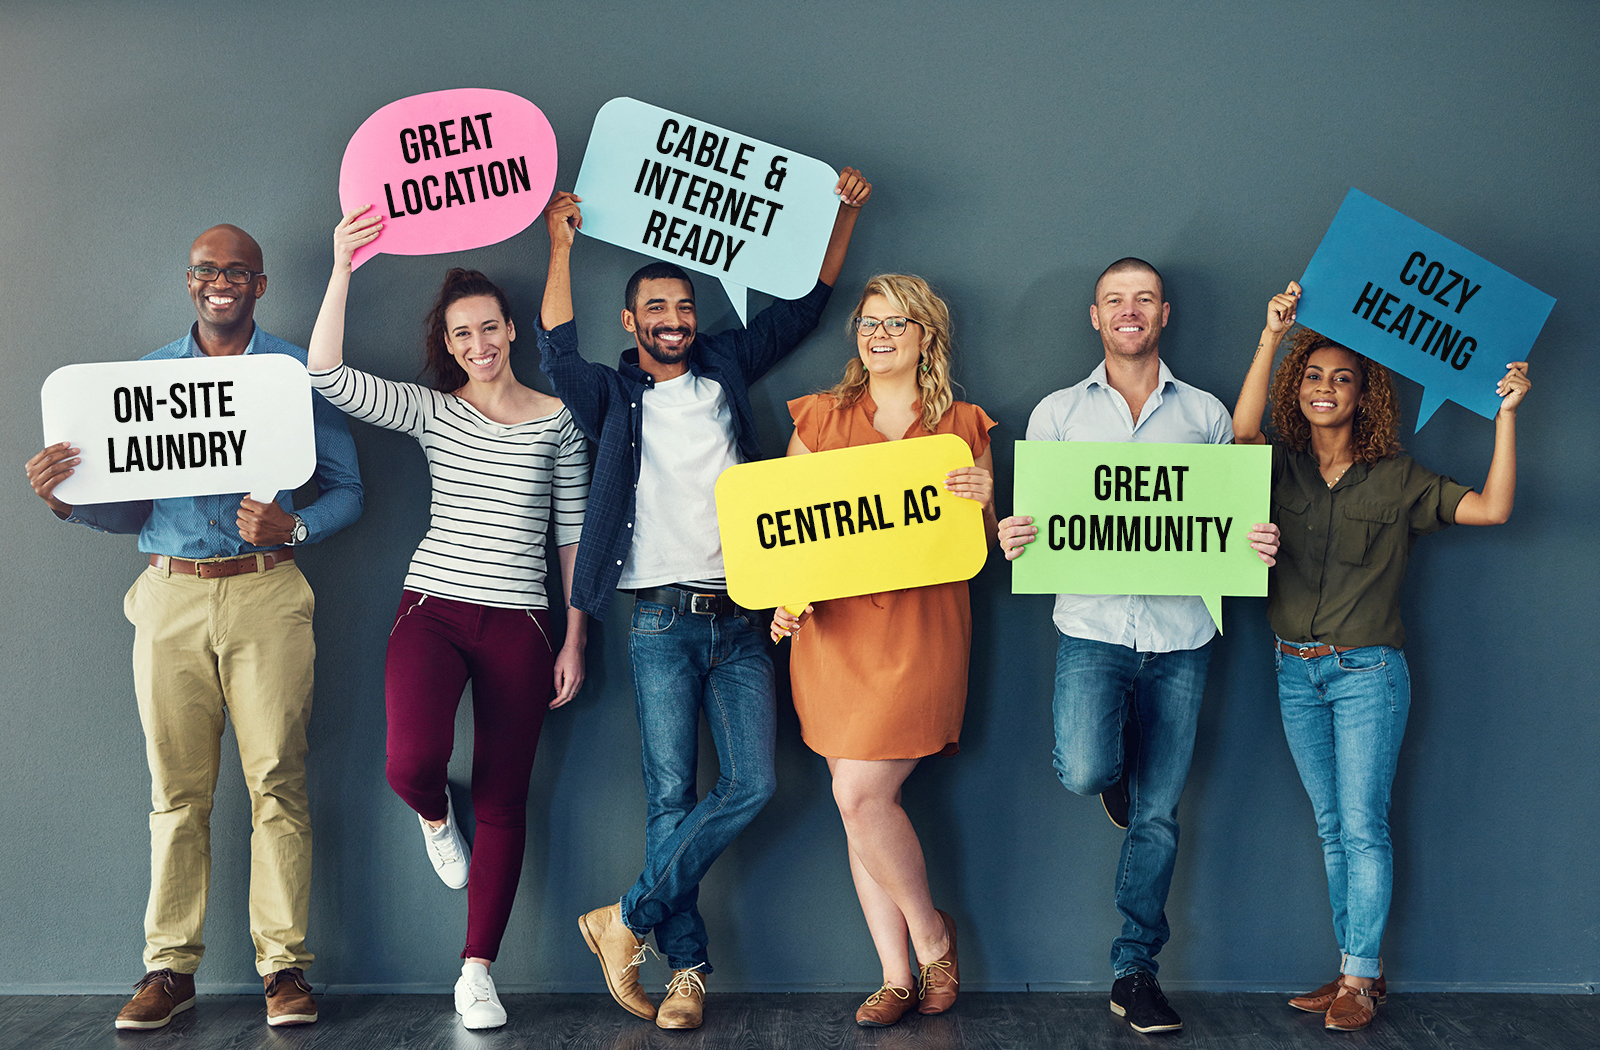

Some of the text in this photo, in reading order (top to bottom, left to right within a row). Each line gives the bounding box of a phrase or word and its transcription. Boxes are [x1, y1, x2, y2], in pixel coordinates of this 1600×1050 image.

[400, 112, 493, 164] GREAT
[657, 118, 788, 193] CABLE &
[384, 155, 532, 219] LOCATION
[634, 158, 784, 237] INTERNET
[641, 209, 747, 273] READY
[1399, 250, 1483, 315] COZY
[1351, 281, 1478, 371] HEATING
[113, 380, 236, 423] ON-SITE
[107, 429, 247, 473] LAUNDRY
[1094, 464, 1189, 502] GREAT
[756, 485, 941, 550] CENTRAL AC
[1048, 514, 1233, 553] COMMUNITY
